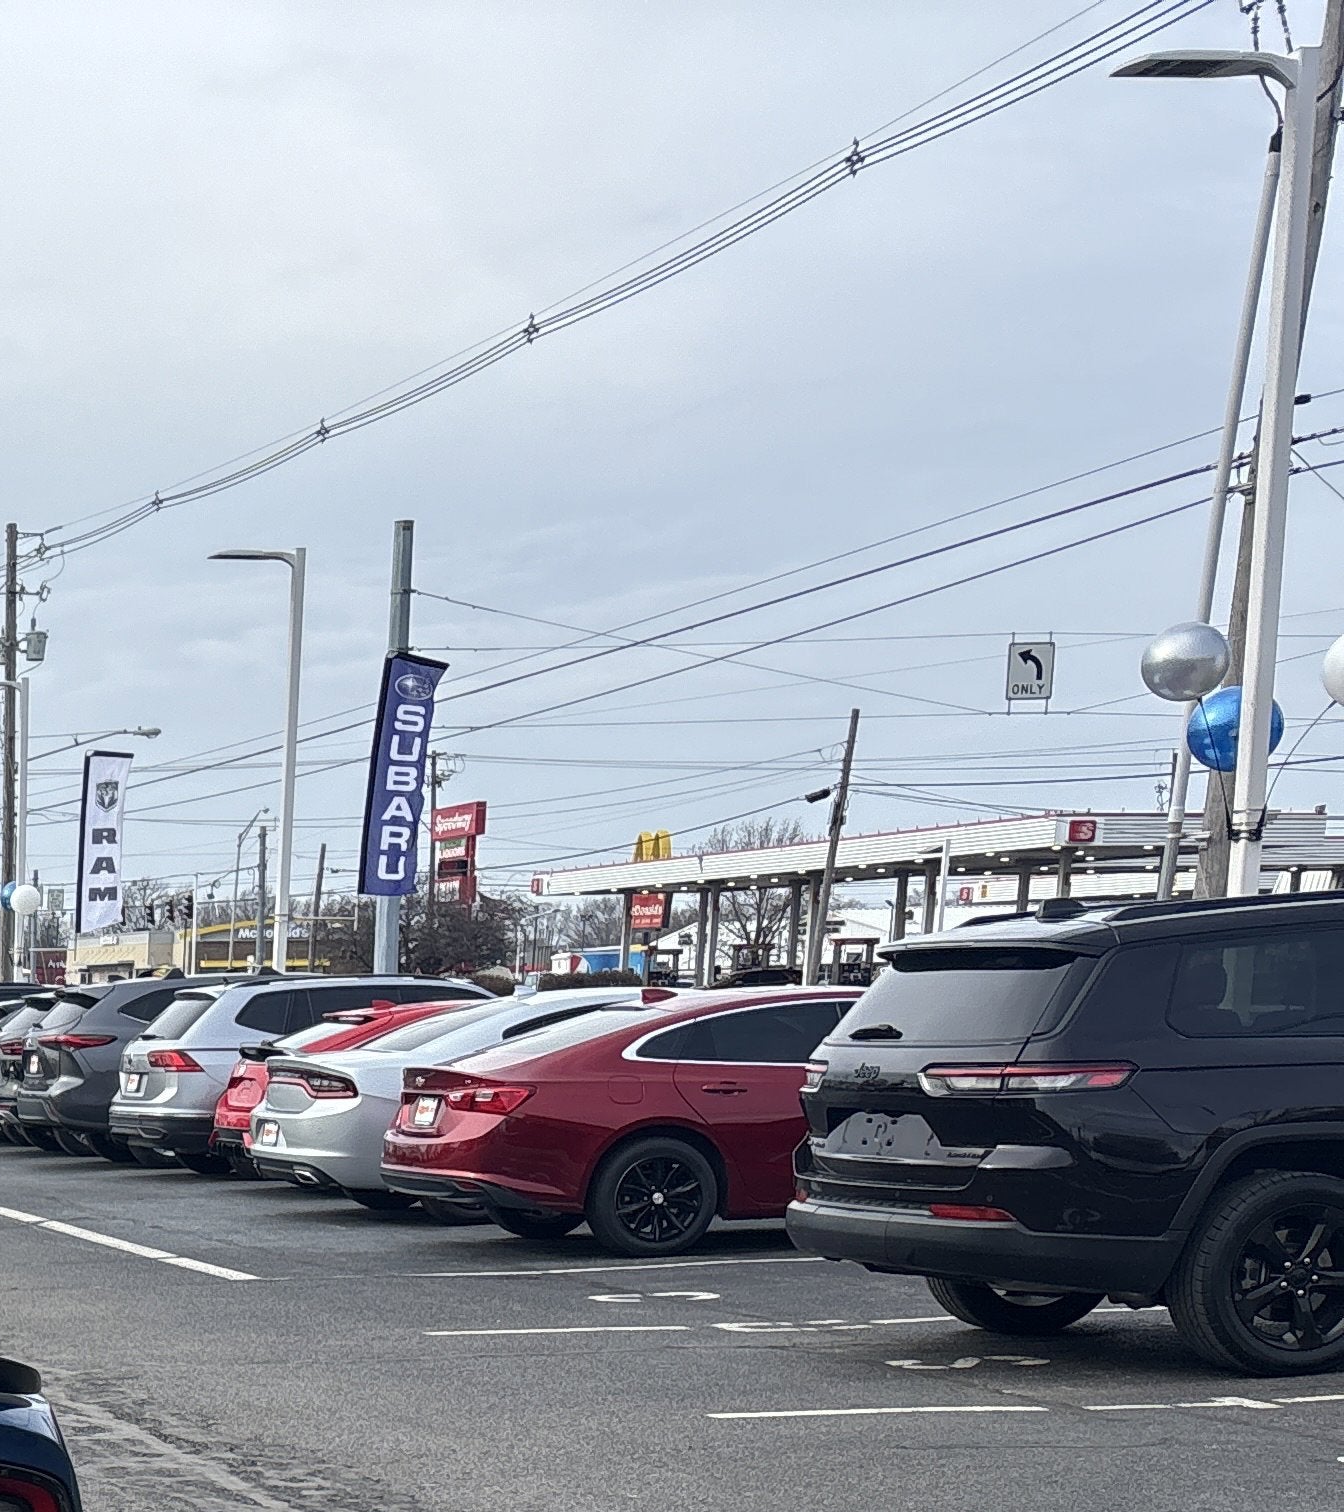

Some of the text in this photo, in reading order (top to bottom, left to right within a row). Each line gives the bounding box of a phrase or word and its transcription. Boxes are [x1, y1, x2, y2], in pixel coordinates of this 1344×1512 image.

[1012, 683, 1045, 695] ONLY
[377, 704, 426, 880] SUBARU
[88, 827, 118, 902] RAM
[853, 1062, 881, 1080] Jeep
